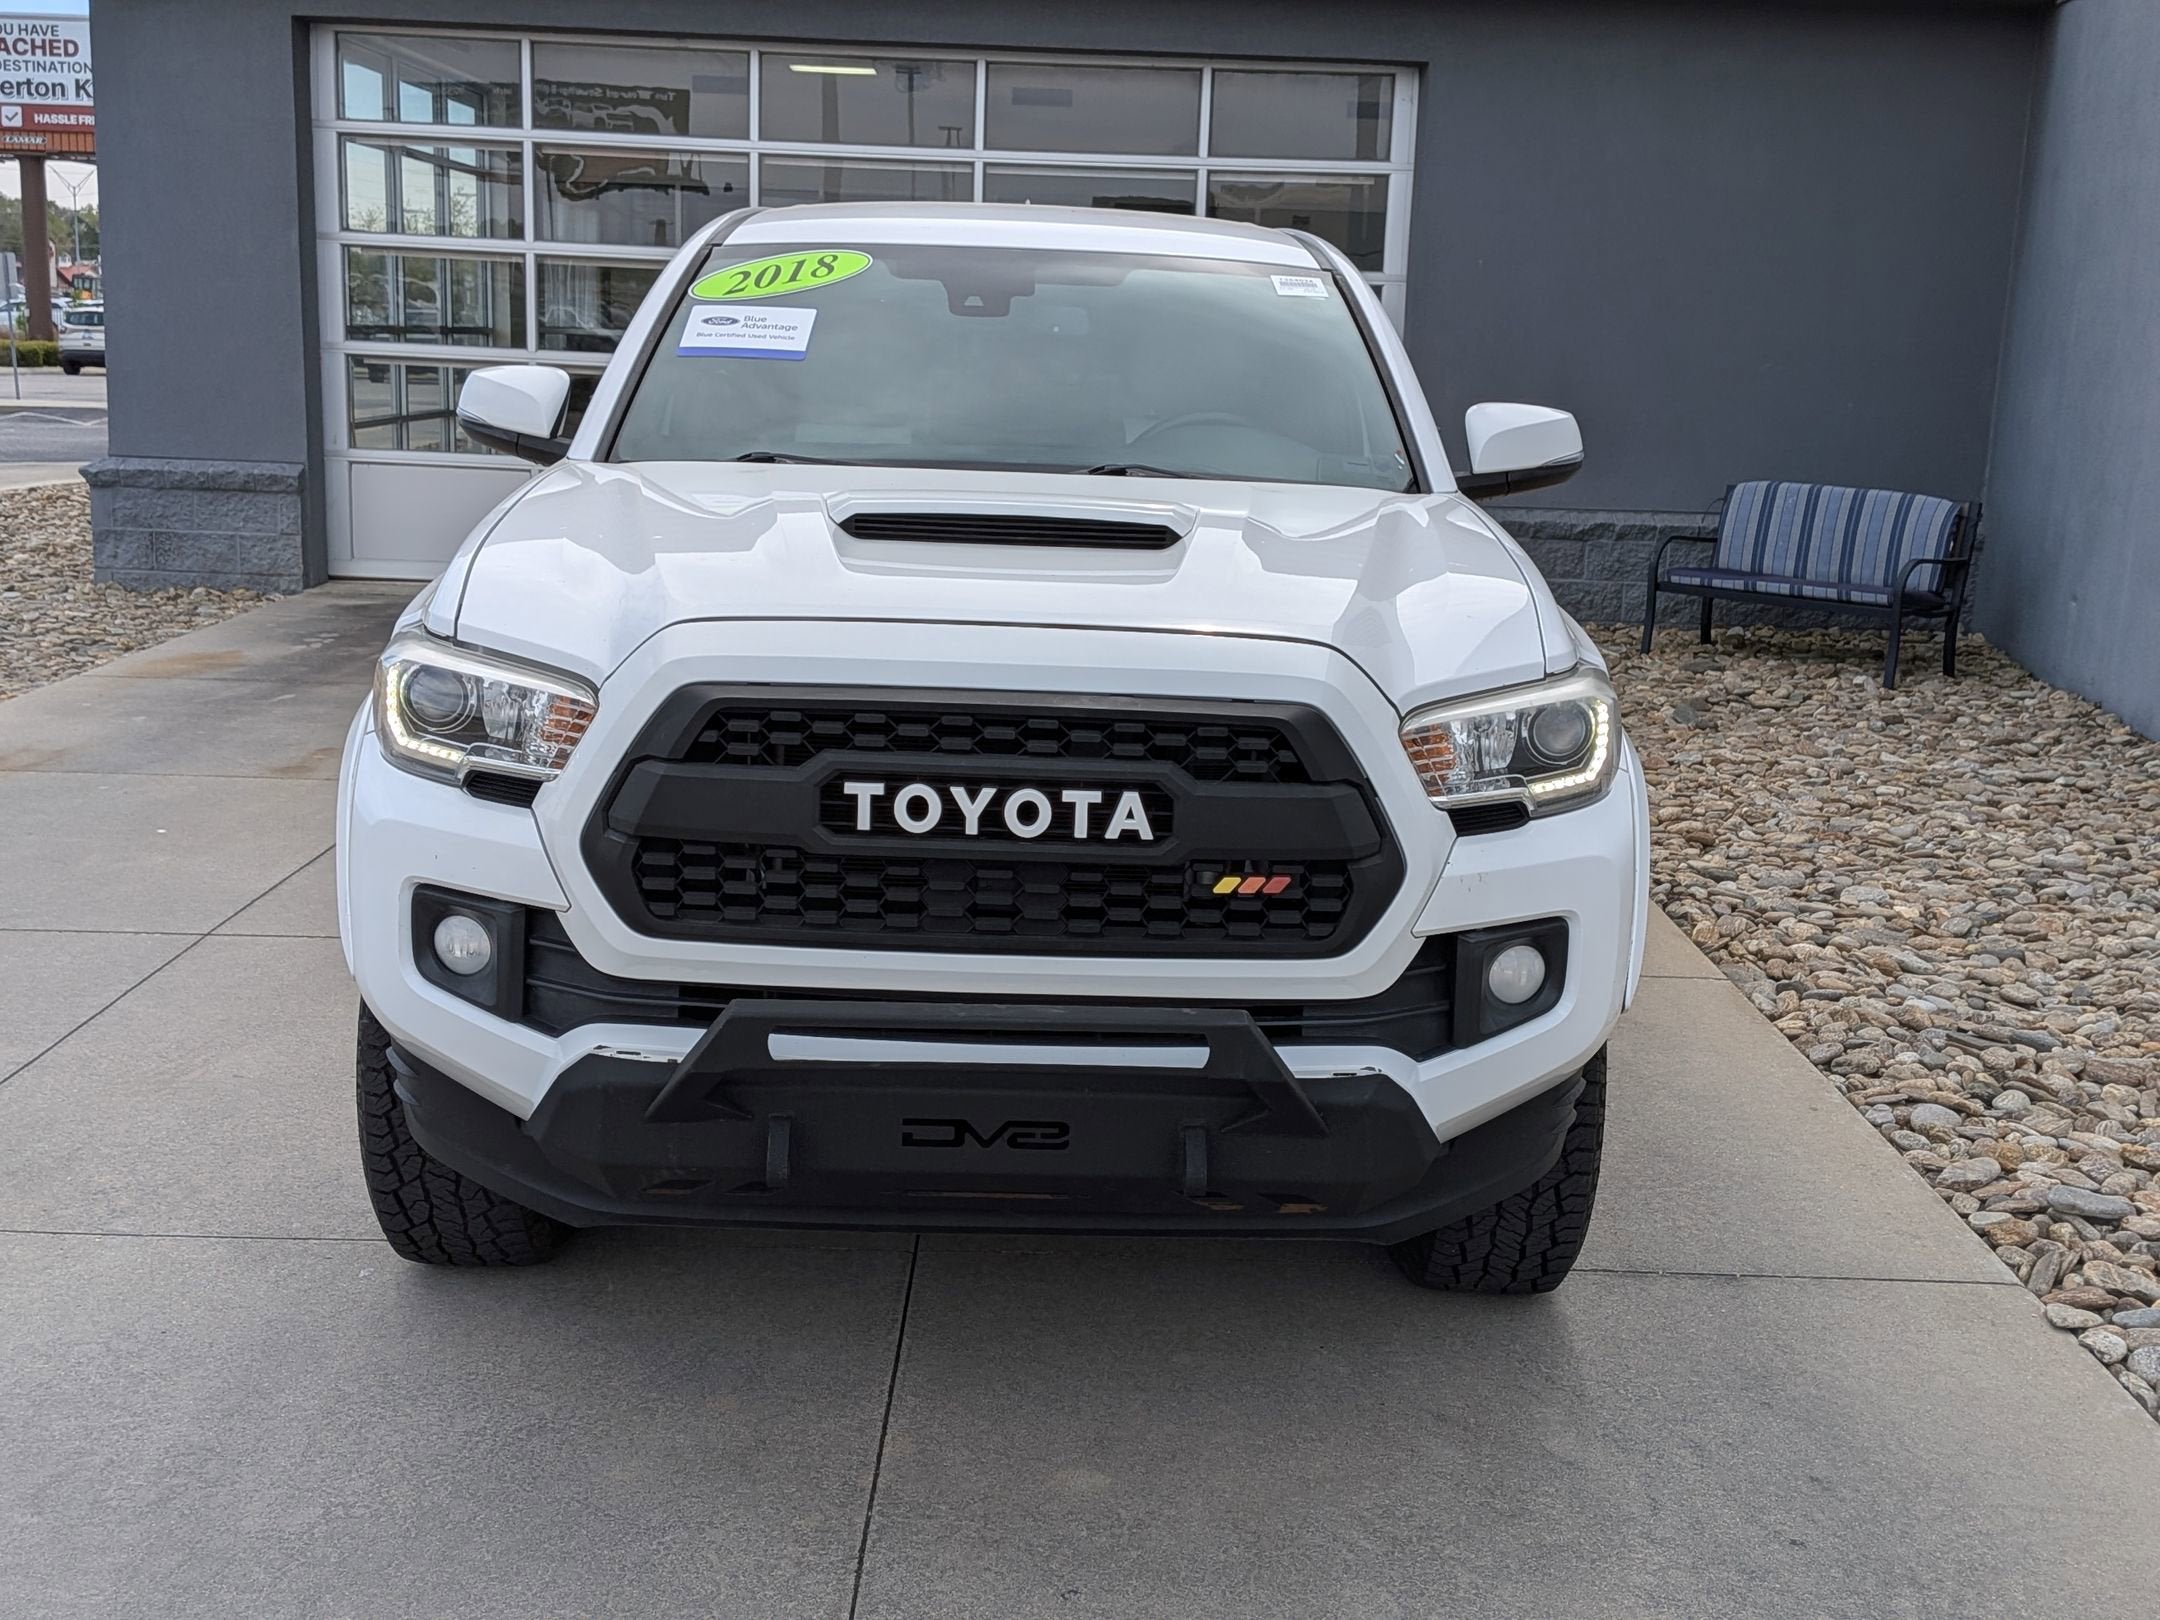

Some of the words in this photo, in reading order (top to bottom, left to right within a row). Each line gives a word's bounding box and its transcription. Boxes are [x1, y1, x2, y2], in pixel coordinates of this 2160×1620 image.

[18, 23, 60, 37] HAVE
[0, 37, 80, 58] ACHED
[0, 59, 93, 74] ESTINATION
[0, 78, 66, 98] erton
[34, 113, 78, 125] HASSLE
[5, 135, 44, 145] LAMAR
[722, 254, 839, 296] 2018
[743, 315, 768, 323] Blue
[741, 322, 798, 332] Advantage
[843, 781, 1154, 841] TOYOTA
